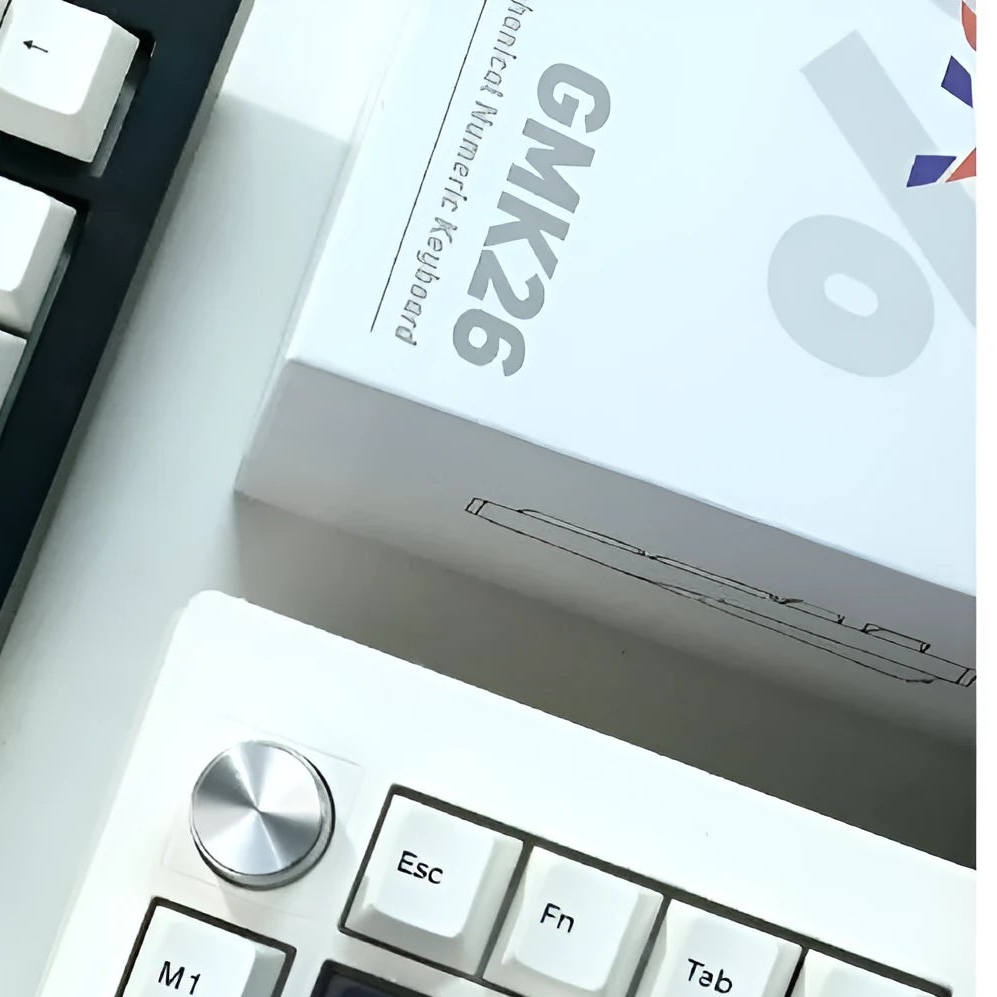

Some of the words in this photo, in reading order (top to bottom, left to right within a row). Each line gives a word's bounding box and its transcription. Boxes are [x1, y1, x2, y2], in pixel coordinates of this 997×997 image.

[437, 100, 499, 214] Numeric
[452, 63, 611, 376] GMK26
[394, 215, 458, 347] Keyboard
[397, 851, 443, 884] Esc
[540, 903, 574, 933] Fn
[158, 961, 200, 995] M1
[688, 958, 732, 993] Tab
